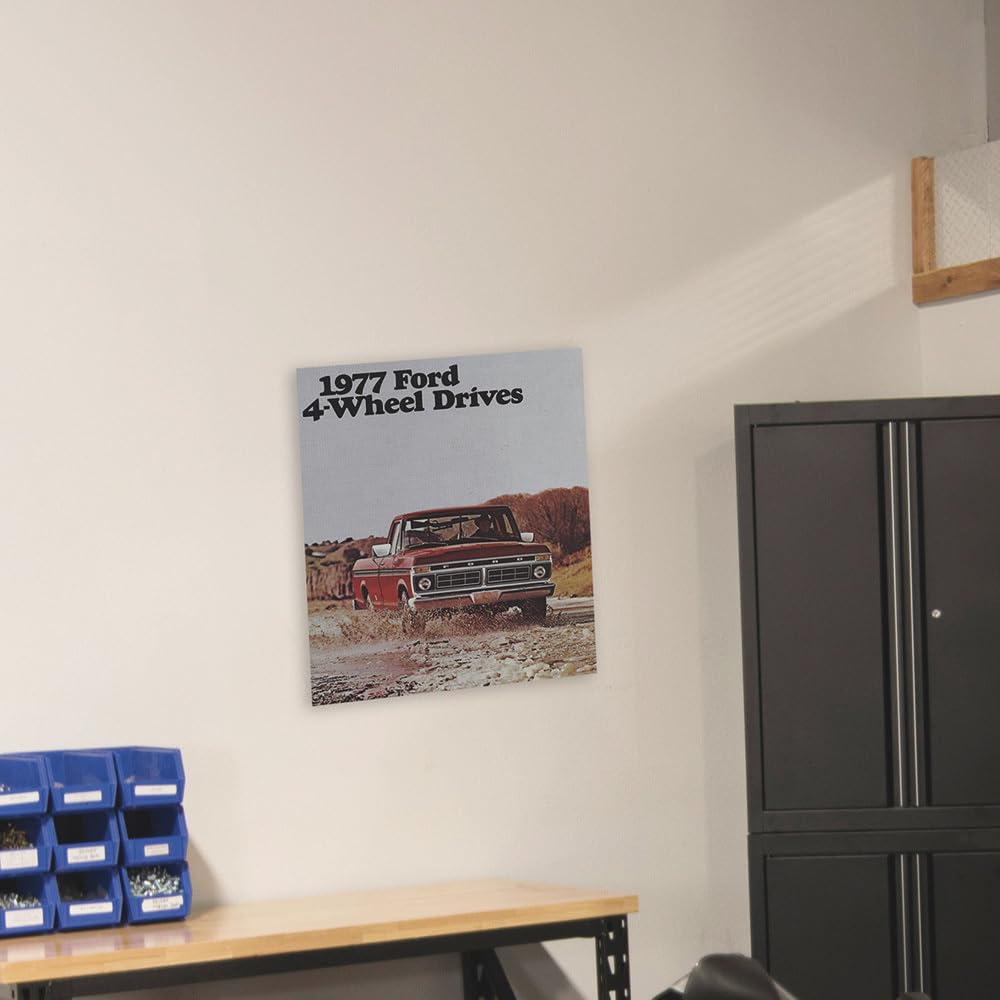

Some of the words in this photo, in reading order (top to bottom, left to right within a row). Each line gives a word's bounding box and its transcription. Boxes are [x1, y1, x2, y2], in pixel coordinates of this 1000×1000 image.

[319, 371, 387, 396] 1977
[393, 364, 460, 390] Ford
[302, 391, 425, 421] 4-Wheel
[433, 387, 524, 410] Drives
